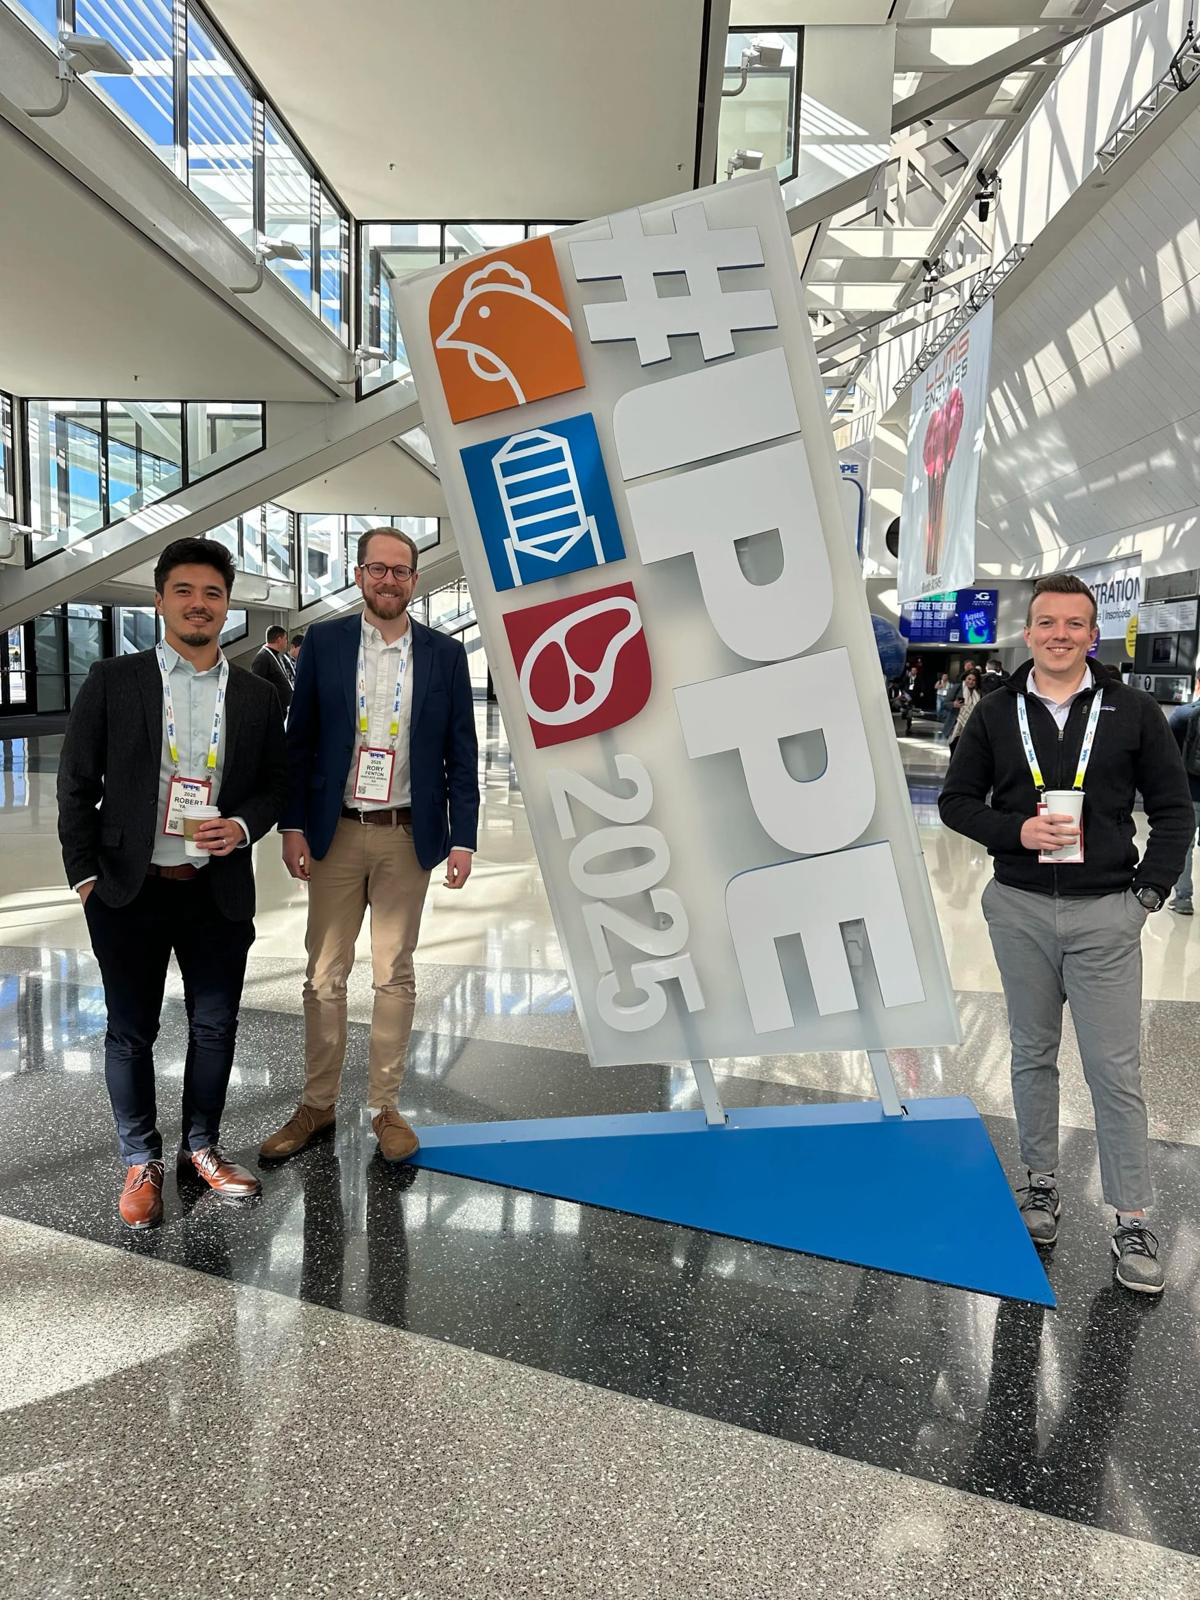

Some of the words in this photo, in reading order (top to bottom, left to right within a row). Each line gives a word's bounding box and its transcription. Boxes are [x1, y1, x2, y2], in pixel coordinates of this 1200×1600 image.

[569, 202, 927, 1034] #IPPE
[174, 797, 203, 806] ROBERT
[549, 753, 705, 1032] 2025
